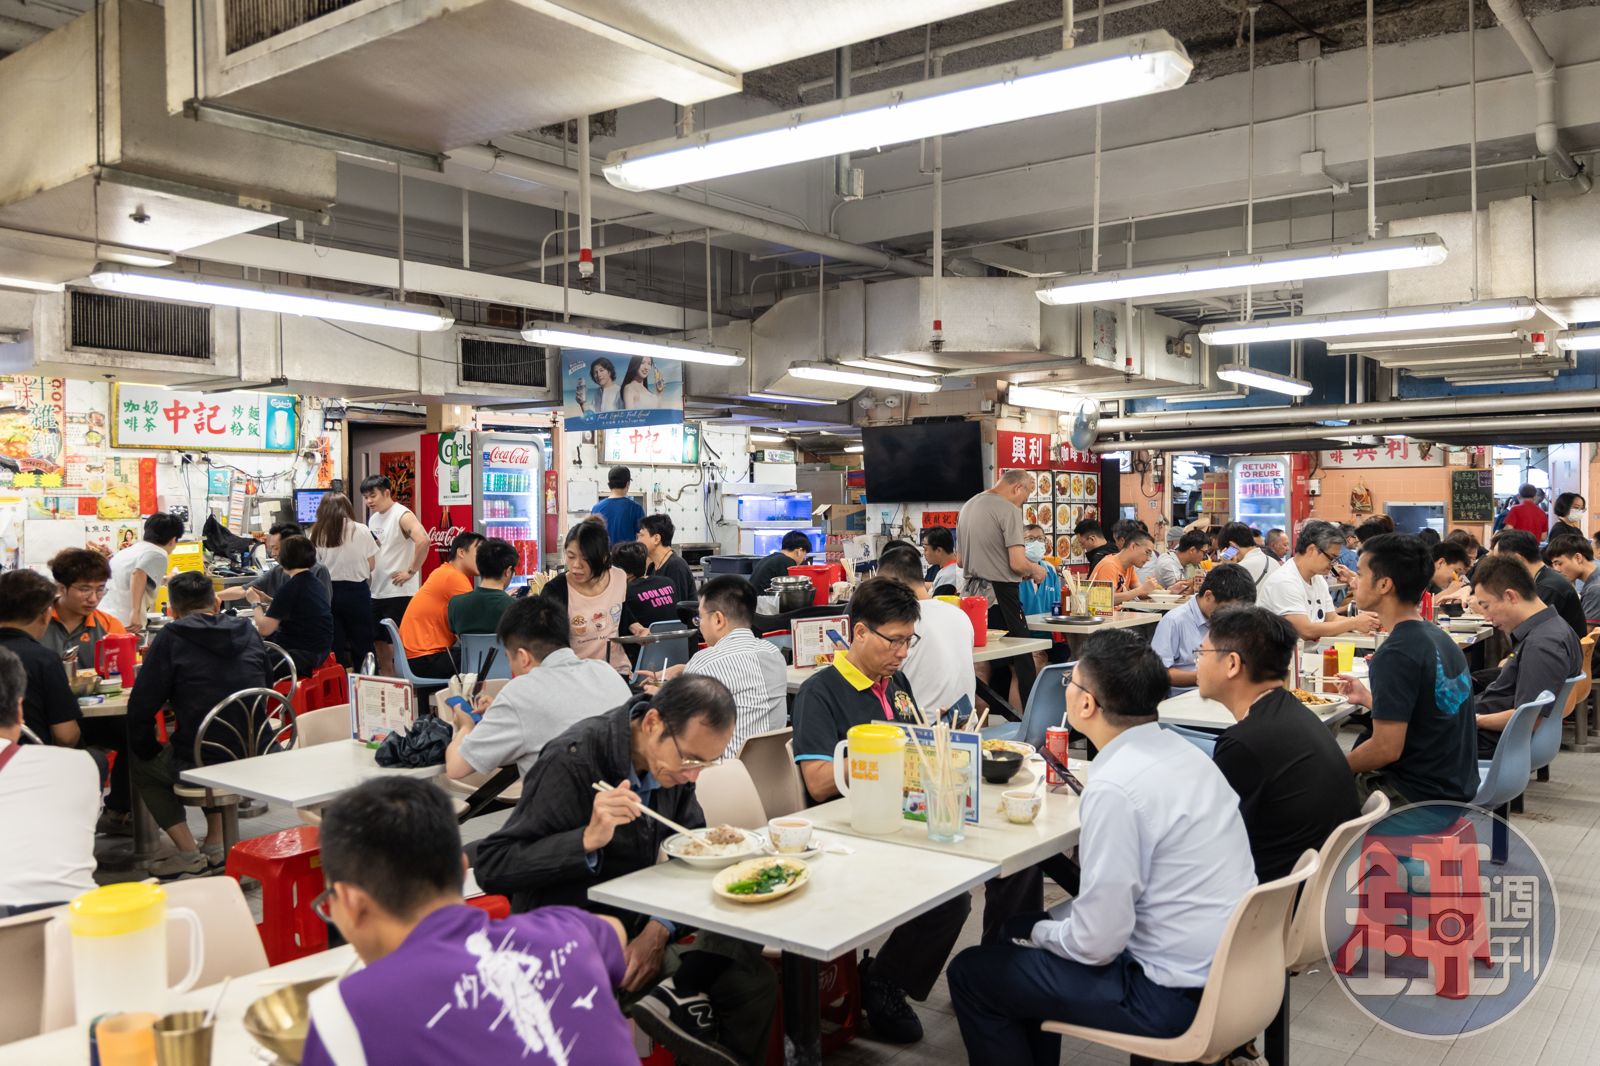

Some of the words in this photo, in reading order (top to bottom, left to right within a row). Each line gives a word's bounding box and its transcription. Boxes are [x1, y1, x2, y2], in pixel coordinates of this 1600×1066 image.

[123, 399, 140, 432] 咖啡
[143, 400, 159, 433] 奶茶
[162, 399, 227, 435] 中記
[231, 404, 245, 437] 炒粉
[629, 428, 661, 454] 中記
[1012, 436, 1043, 465] 興利
[1242, 463, 1278, 471] RETURN
[1253, 470, 1281, 478] REUSE
[638, 590, 661, 602] LOOK
[660, 585, 674, 595] OUT!
[651, 596, 673, 608] LOTSO
